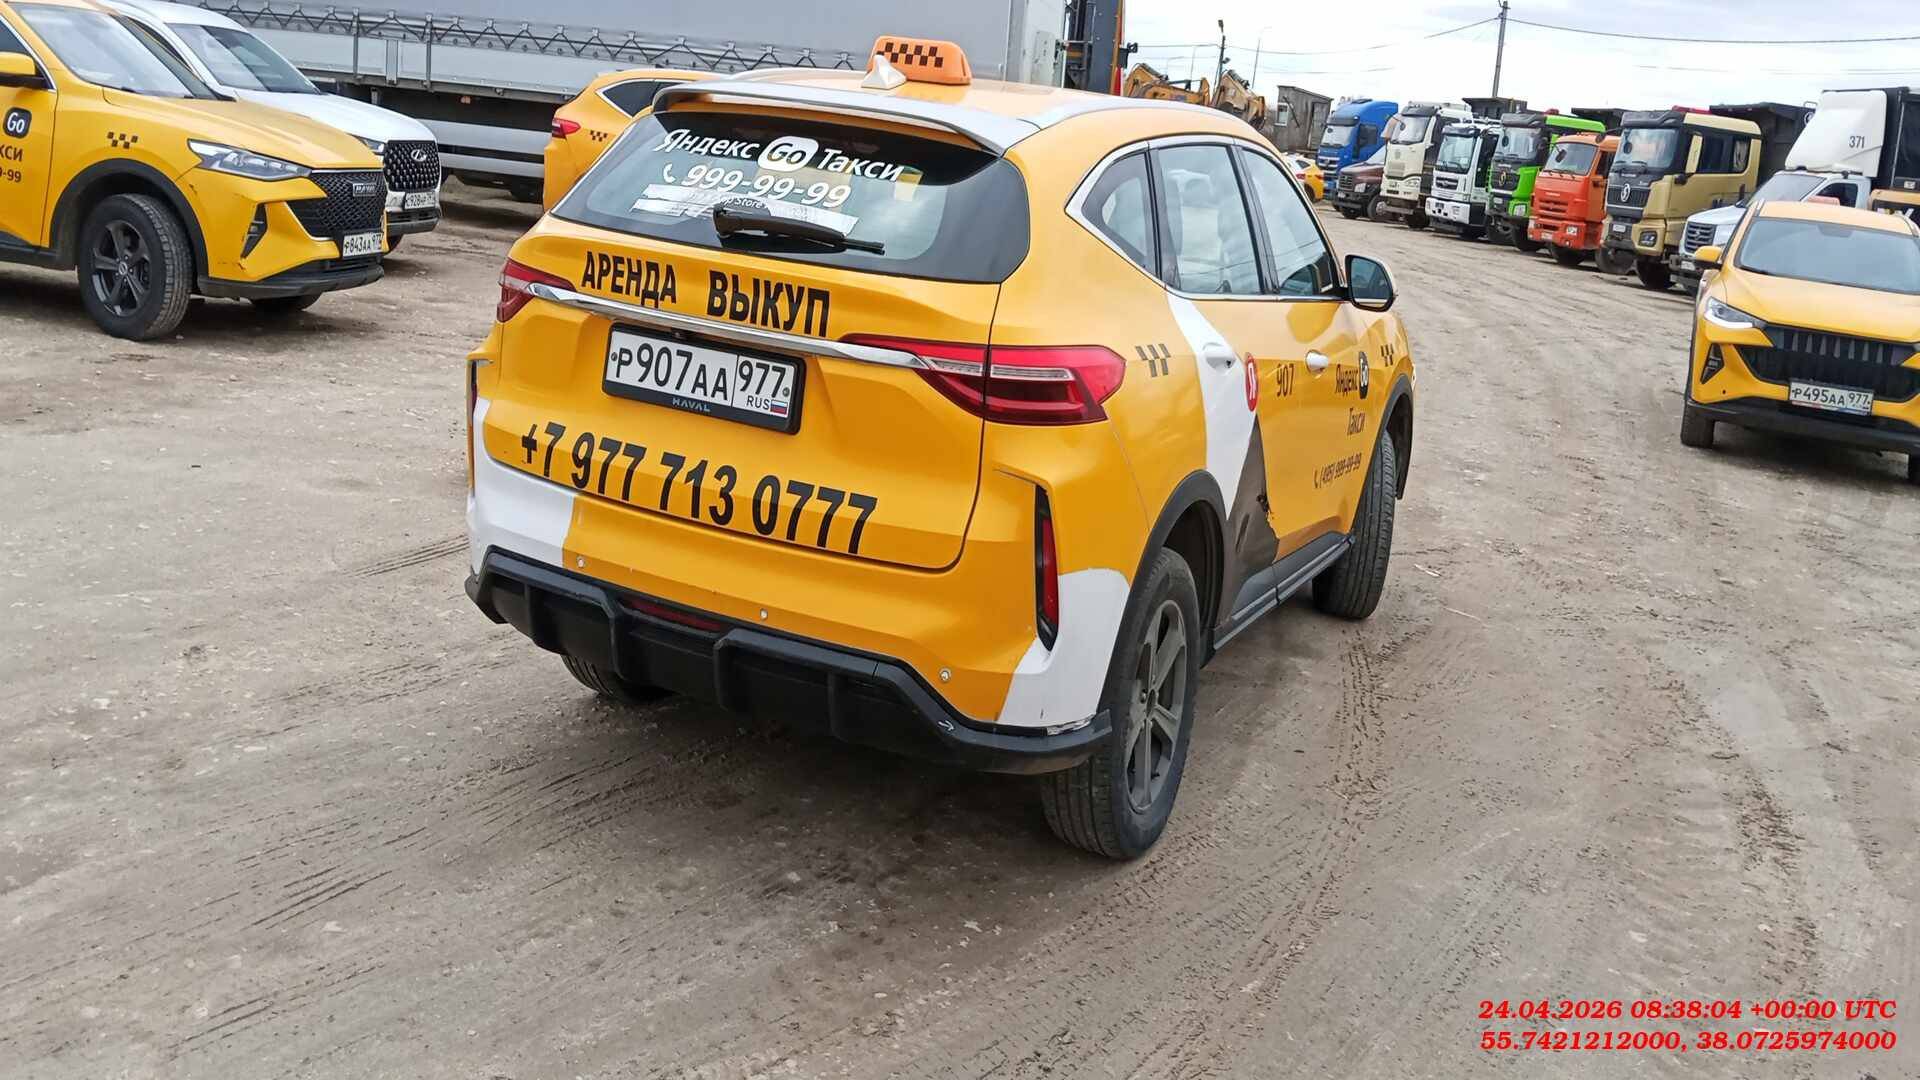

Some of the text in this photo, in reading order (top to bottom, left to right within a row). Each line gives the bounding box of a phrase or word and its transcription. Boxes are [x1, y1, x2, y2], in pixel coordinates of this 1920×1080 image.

[6, 111, 25, 133] Go
[653, 128, 759, 160] Яндекс
[816, 148, 905, 183] Такси
[1848, 135, 1865, 149] 371
[681, 164, 851, 208] 999-99-99
[734, 196, 763, 209] Store
[581, 251, 831, 338] АРЕНДА ВЫКУП
[738, 359, 787, 399] 977
[1276, 363, 1295, 397] 907
[1336, 363, 1360, 395] Яндекс
[671, 397, 712, 413] HAVAL
[745, 395, 771, 411] RUS
[1346, 407, 1366, 437] Такси
[521, 421, 879, 555] +7 977 713 0777
